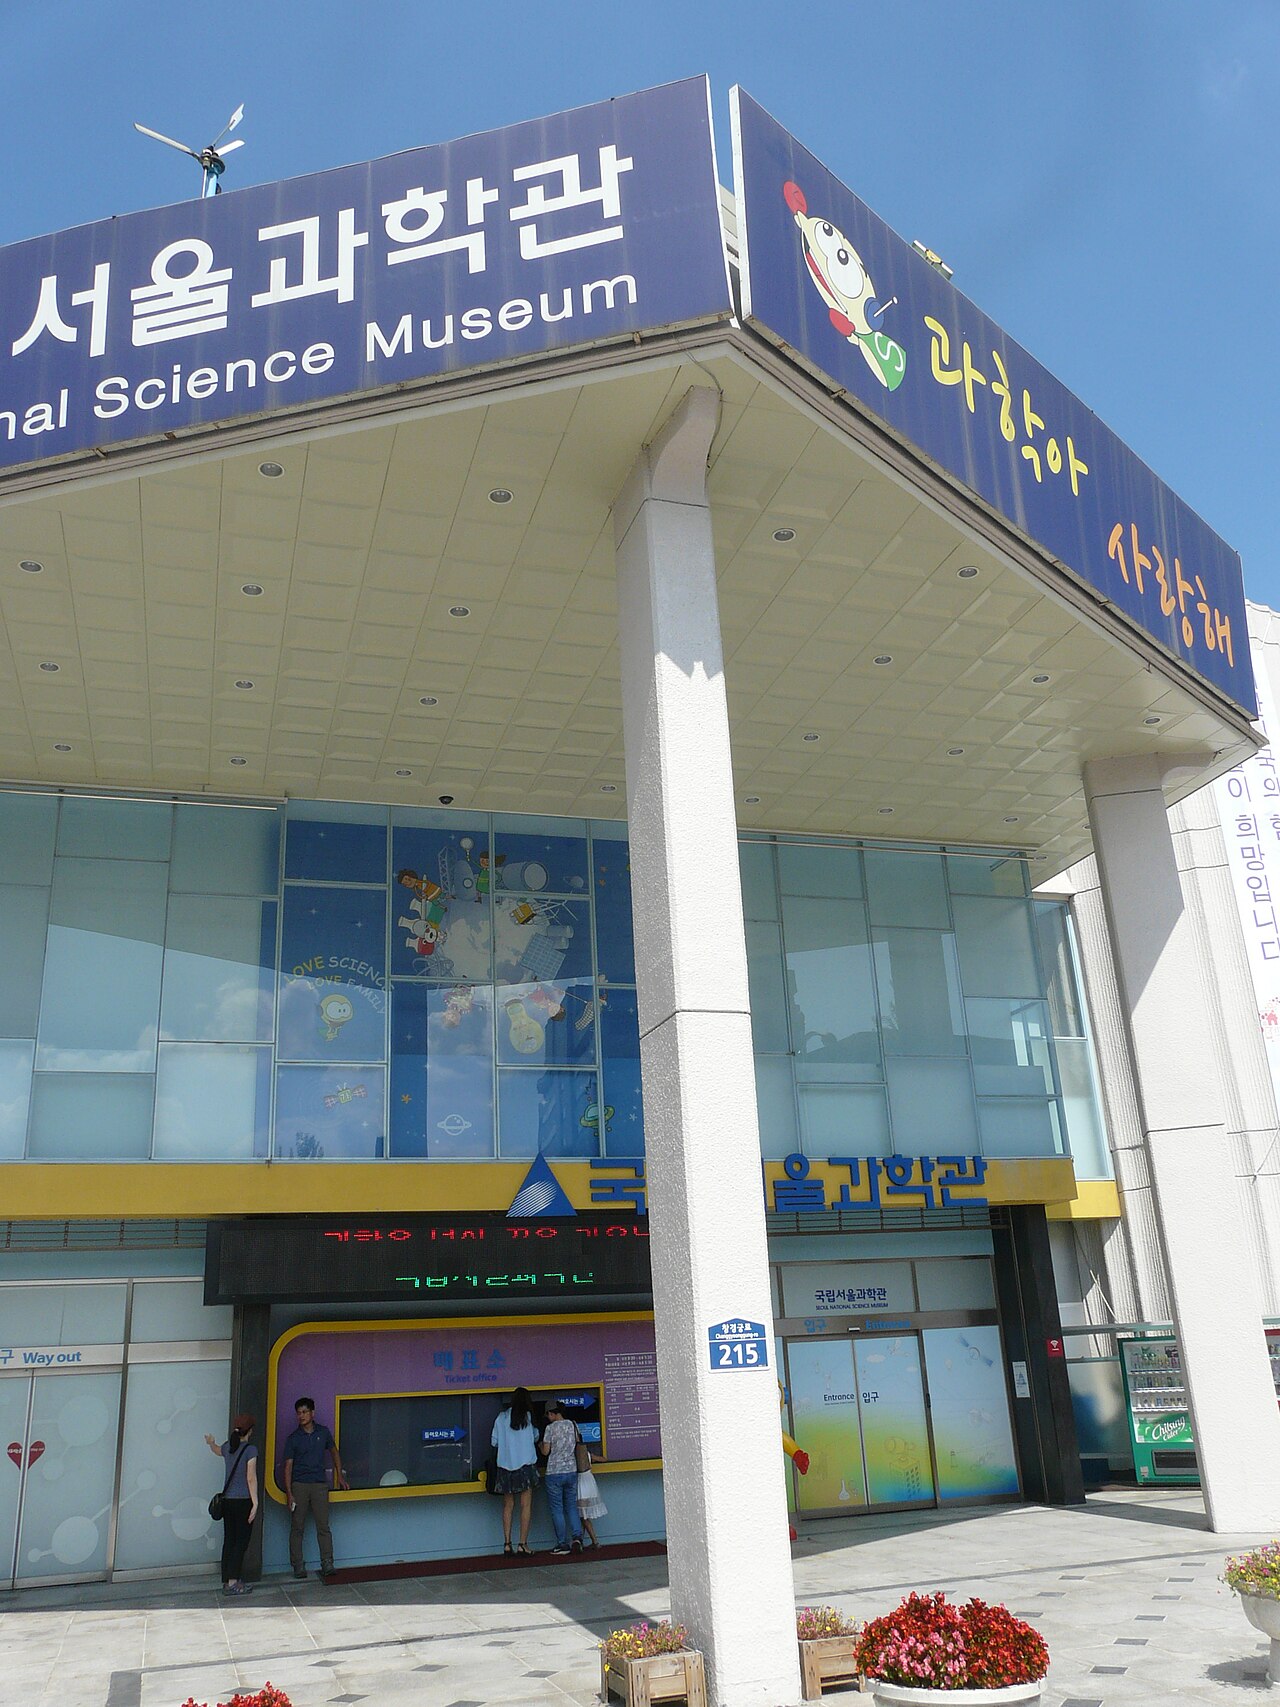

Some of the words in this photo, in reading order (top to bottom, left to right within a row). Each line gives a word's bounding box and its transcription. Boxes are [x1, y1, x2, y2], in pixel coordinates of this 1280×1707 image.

[12, 144, 635, 357] 서울과학관
[93, 342, 336, 421] Science
[366, 274, 638, 363] Museum
[923, 315, 1089, 497] 과학아
[1108, 522, 1234, 667] 사랑해
[284, 955, 326, 985] LOVE
[306, 975, 342, 990] LOVE
[815, 1288, 887, 1303] 국립서울과학관
[23, 1352, 54, 1366] Way
[57, 1351, 81, 1363] out
[719, 1343, 758, 1366] 215
[445, 1374, 470, 1383] Ticket
[473, 1372, 497, 1382] office
[823, 1394, 855, 1402] Entrance
[862, 1391, 879, 1404] 입구
